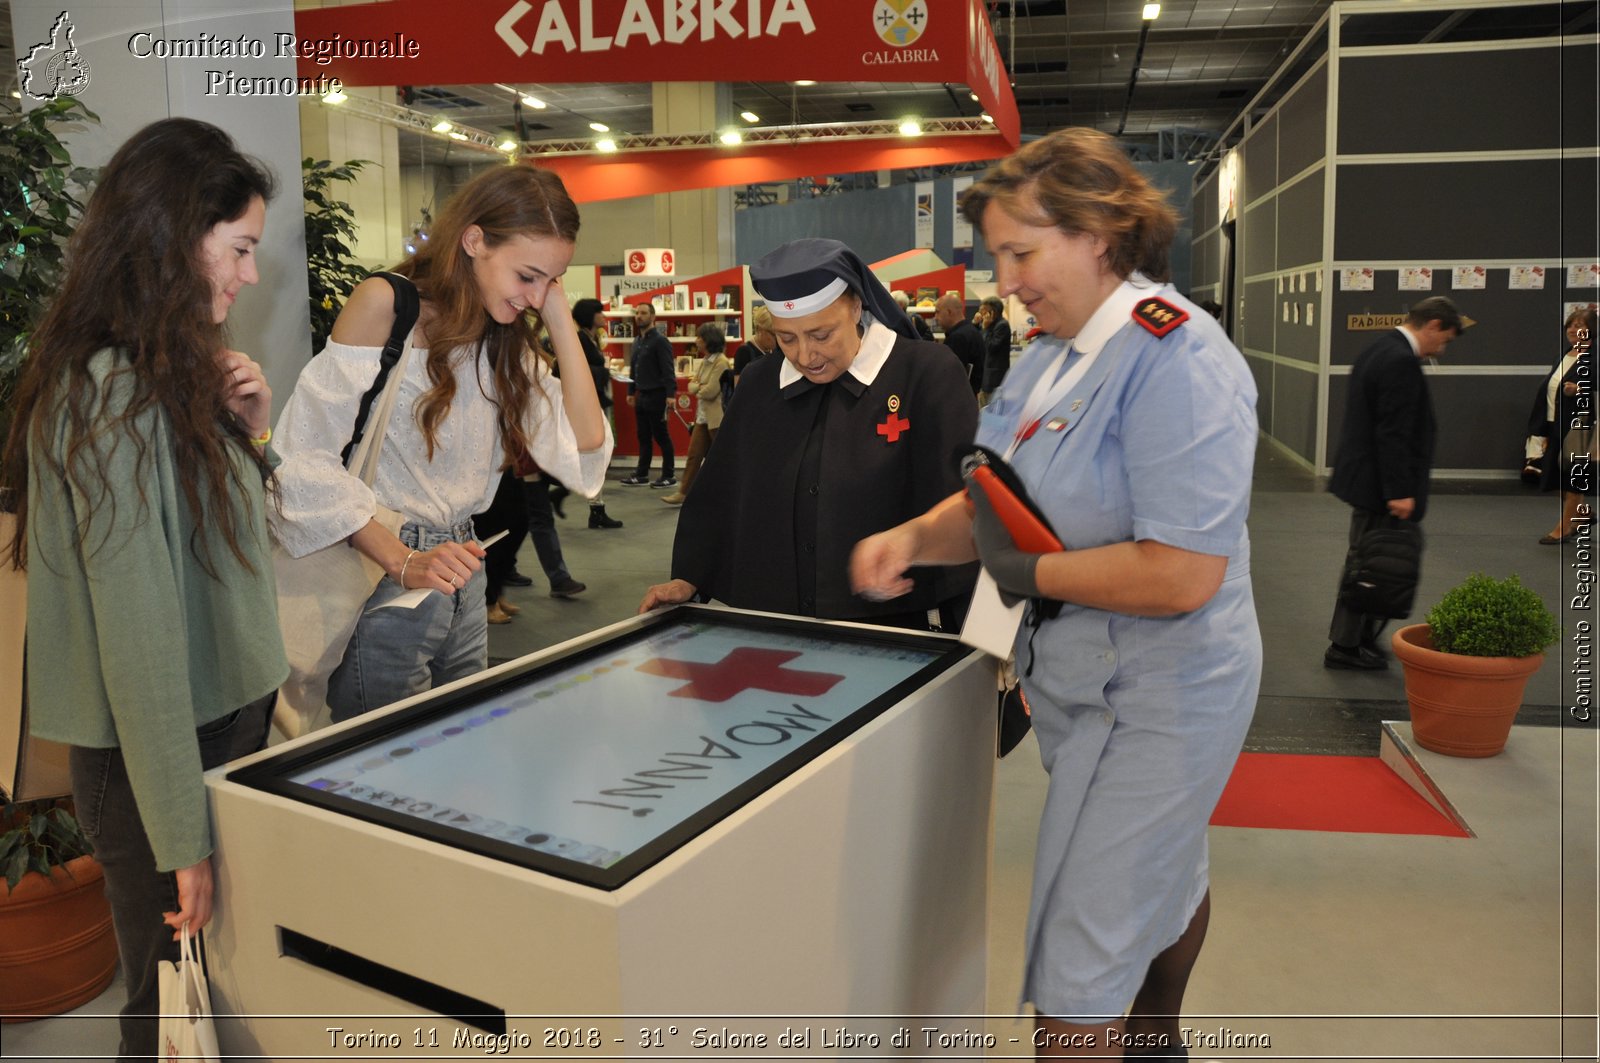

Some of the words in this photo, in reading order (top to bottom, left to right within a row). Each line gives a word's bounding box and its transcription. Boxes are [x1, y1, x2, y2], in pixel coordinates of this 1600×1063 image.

[495, 0, 817, 56] CALABRIA
[862, 48, 939, 65] CALABRIA
[1351, 315, 1409, 328] PADIGLIO
